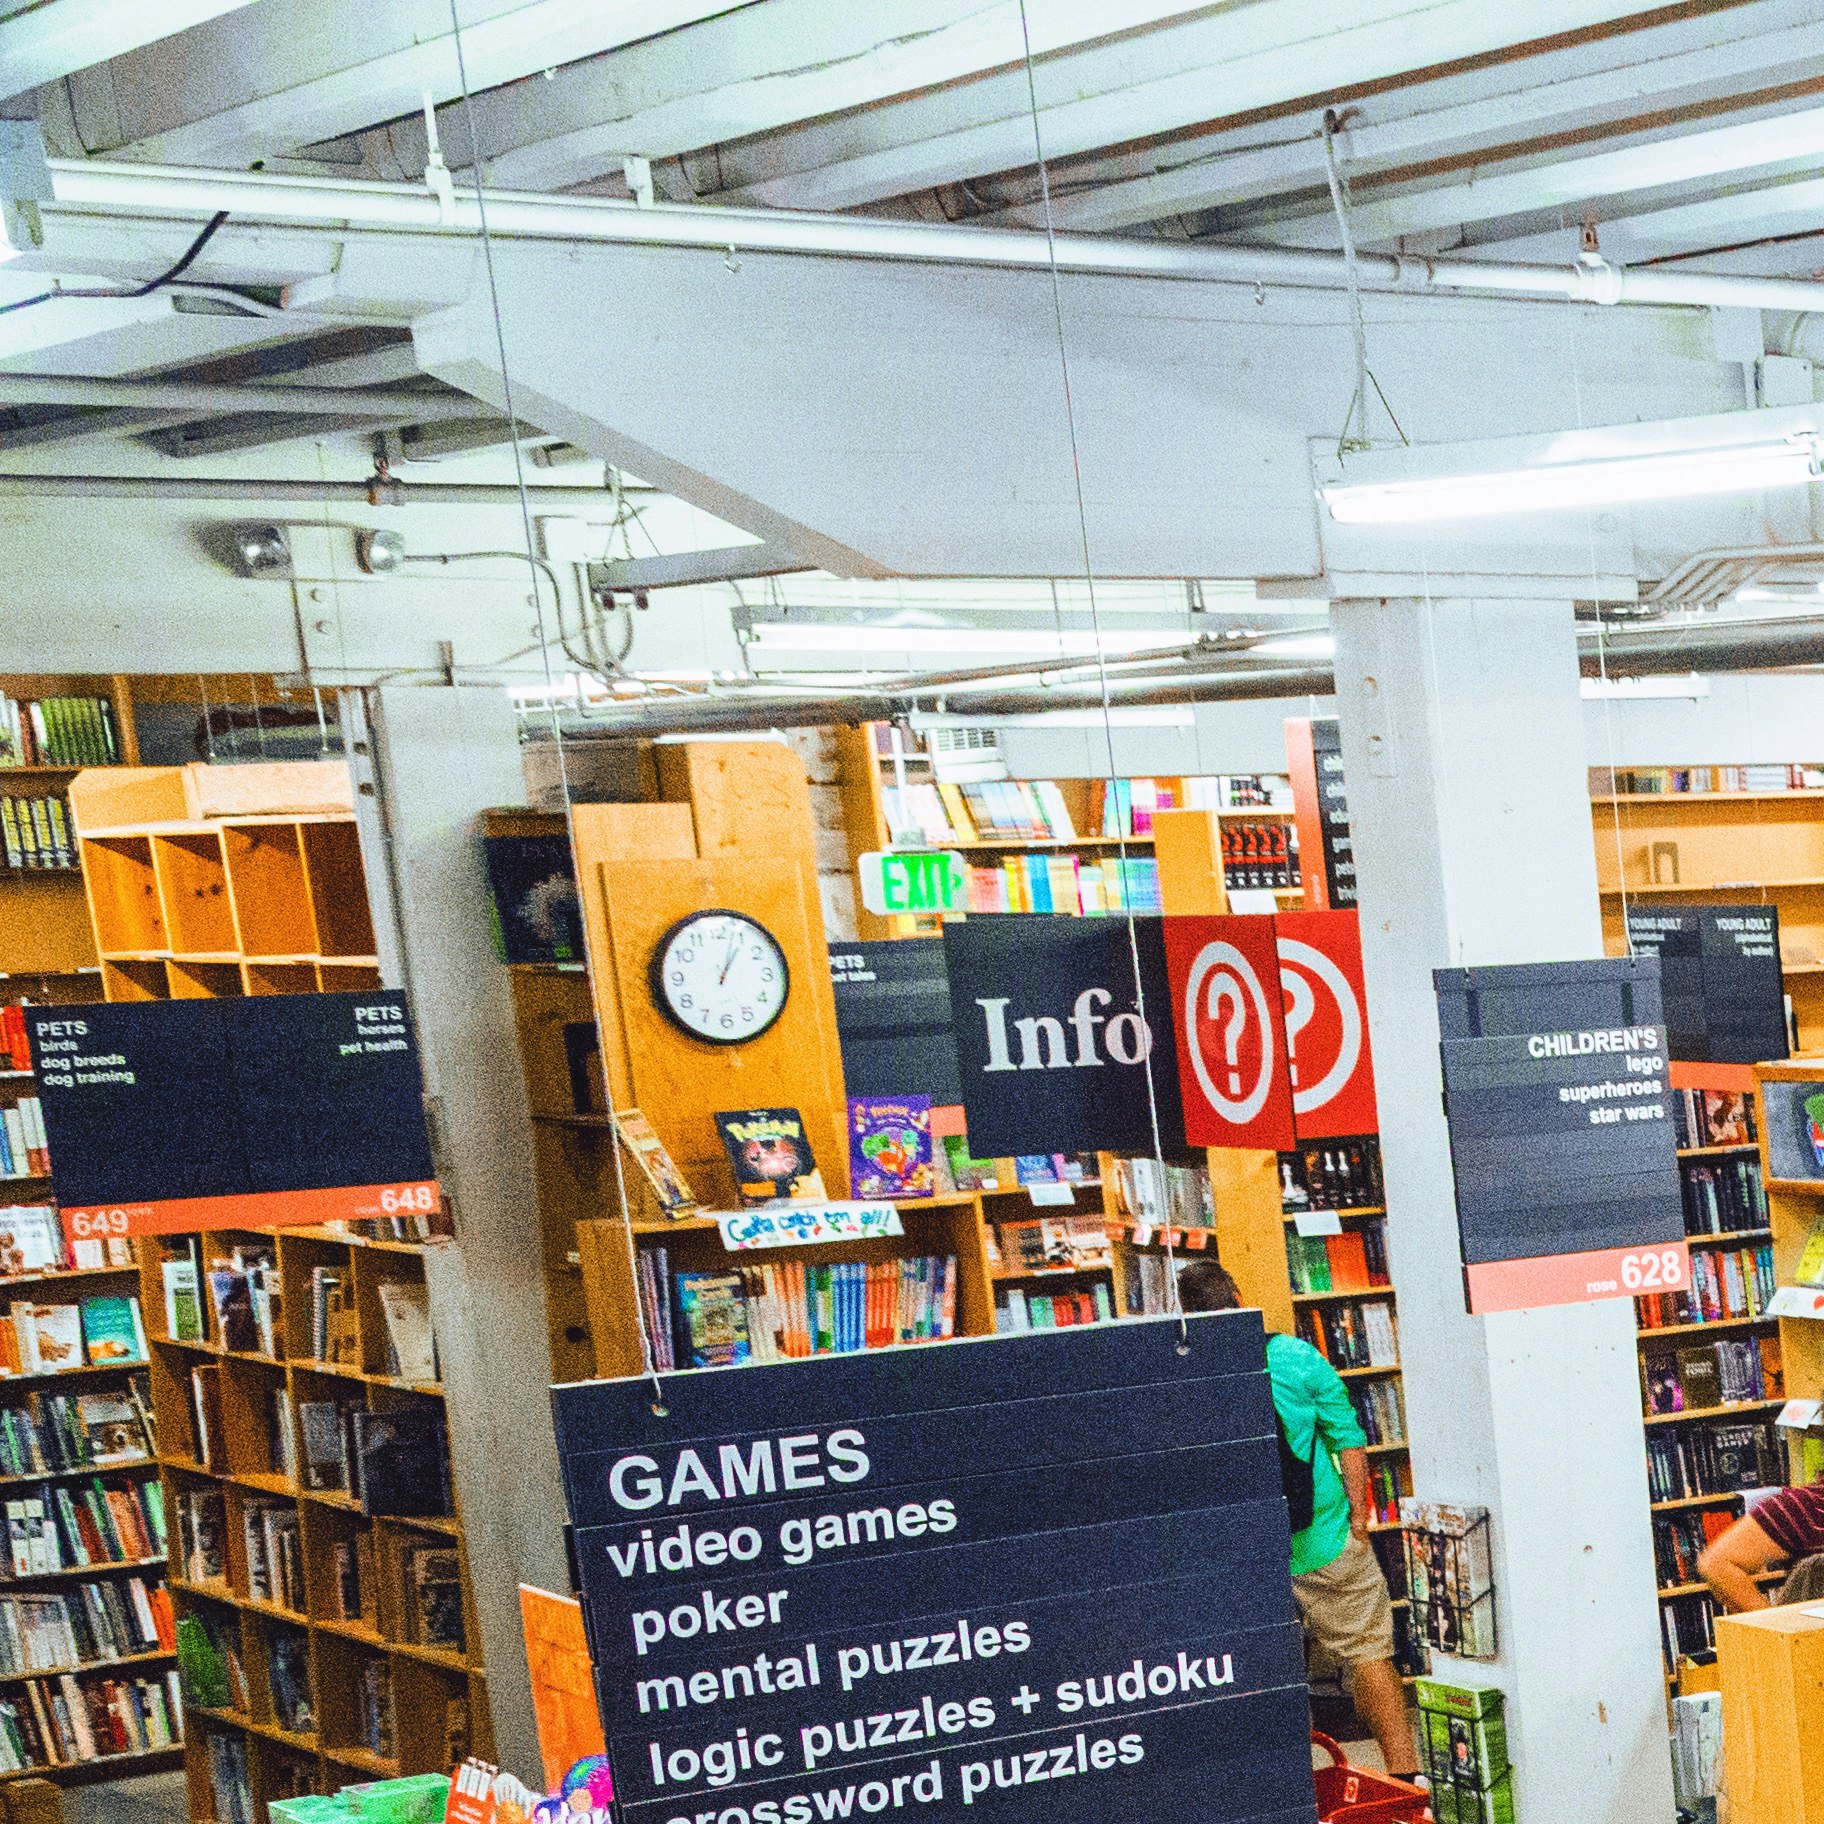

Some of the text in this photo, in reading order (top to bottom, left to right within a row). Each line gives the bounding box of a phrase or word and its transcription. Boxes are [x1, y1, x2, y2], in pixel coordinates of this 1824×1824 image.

[882, 855, 951, 909] EXIT
[355, 1006, 402, 1021] PETS
[37, 1021, 88, 1036] PETS
[976, 988, 1152, 1072] Info
[40, 1040, 78, 1052] birds
[340, 1039, 407, 1055] pet health
[1528, 1028, 1658, 1058] CHILDREN'S
[41, 1053, 125, 1070] dog breeds
[1626, 1055, 1663, 1075] lego
[44, 1070, 135, 1087] dog training
[1560, 1080, 1662, 1103] superheroes
[1590, 1104, 1664, 1124] star wars
[381, 1187, 433, 1212] 648
[73, 1209, 128, 1236] 649
[1587, 1251, 1681, 1293] rose 628
[609, 1429, 870, 1511] GAMES
[607, 1494, 958, 1577] video games
[632, 1587, 788, 1655] poker
[636, 1618, 1031, 1713] mental puzzles
[649, 1651, 1234, 1787] logic puzzles + sudoku
[961, 1732, 1144, 1804] puzzles
